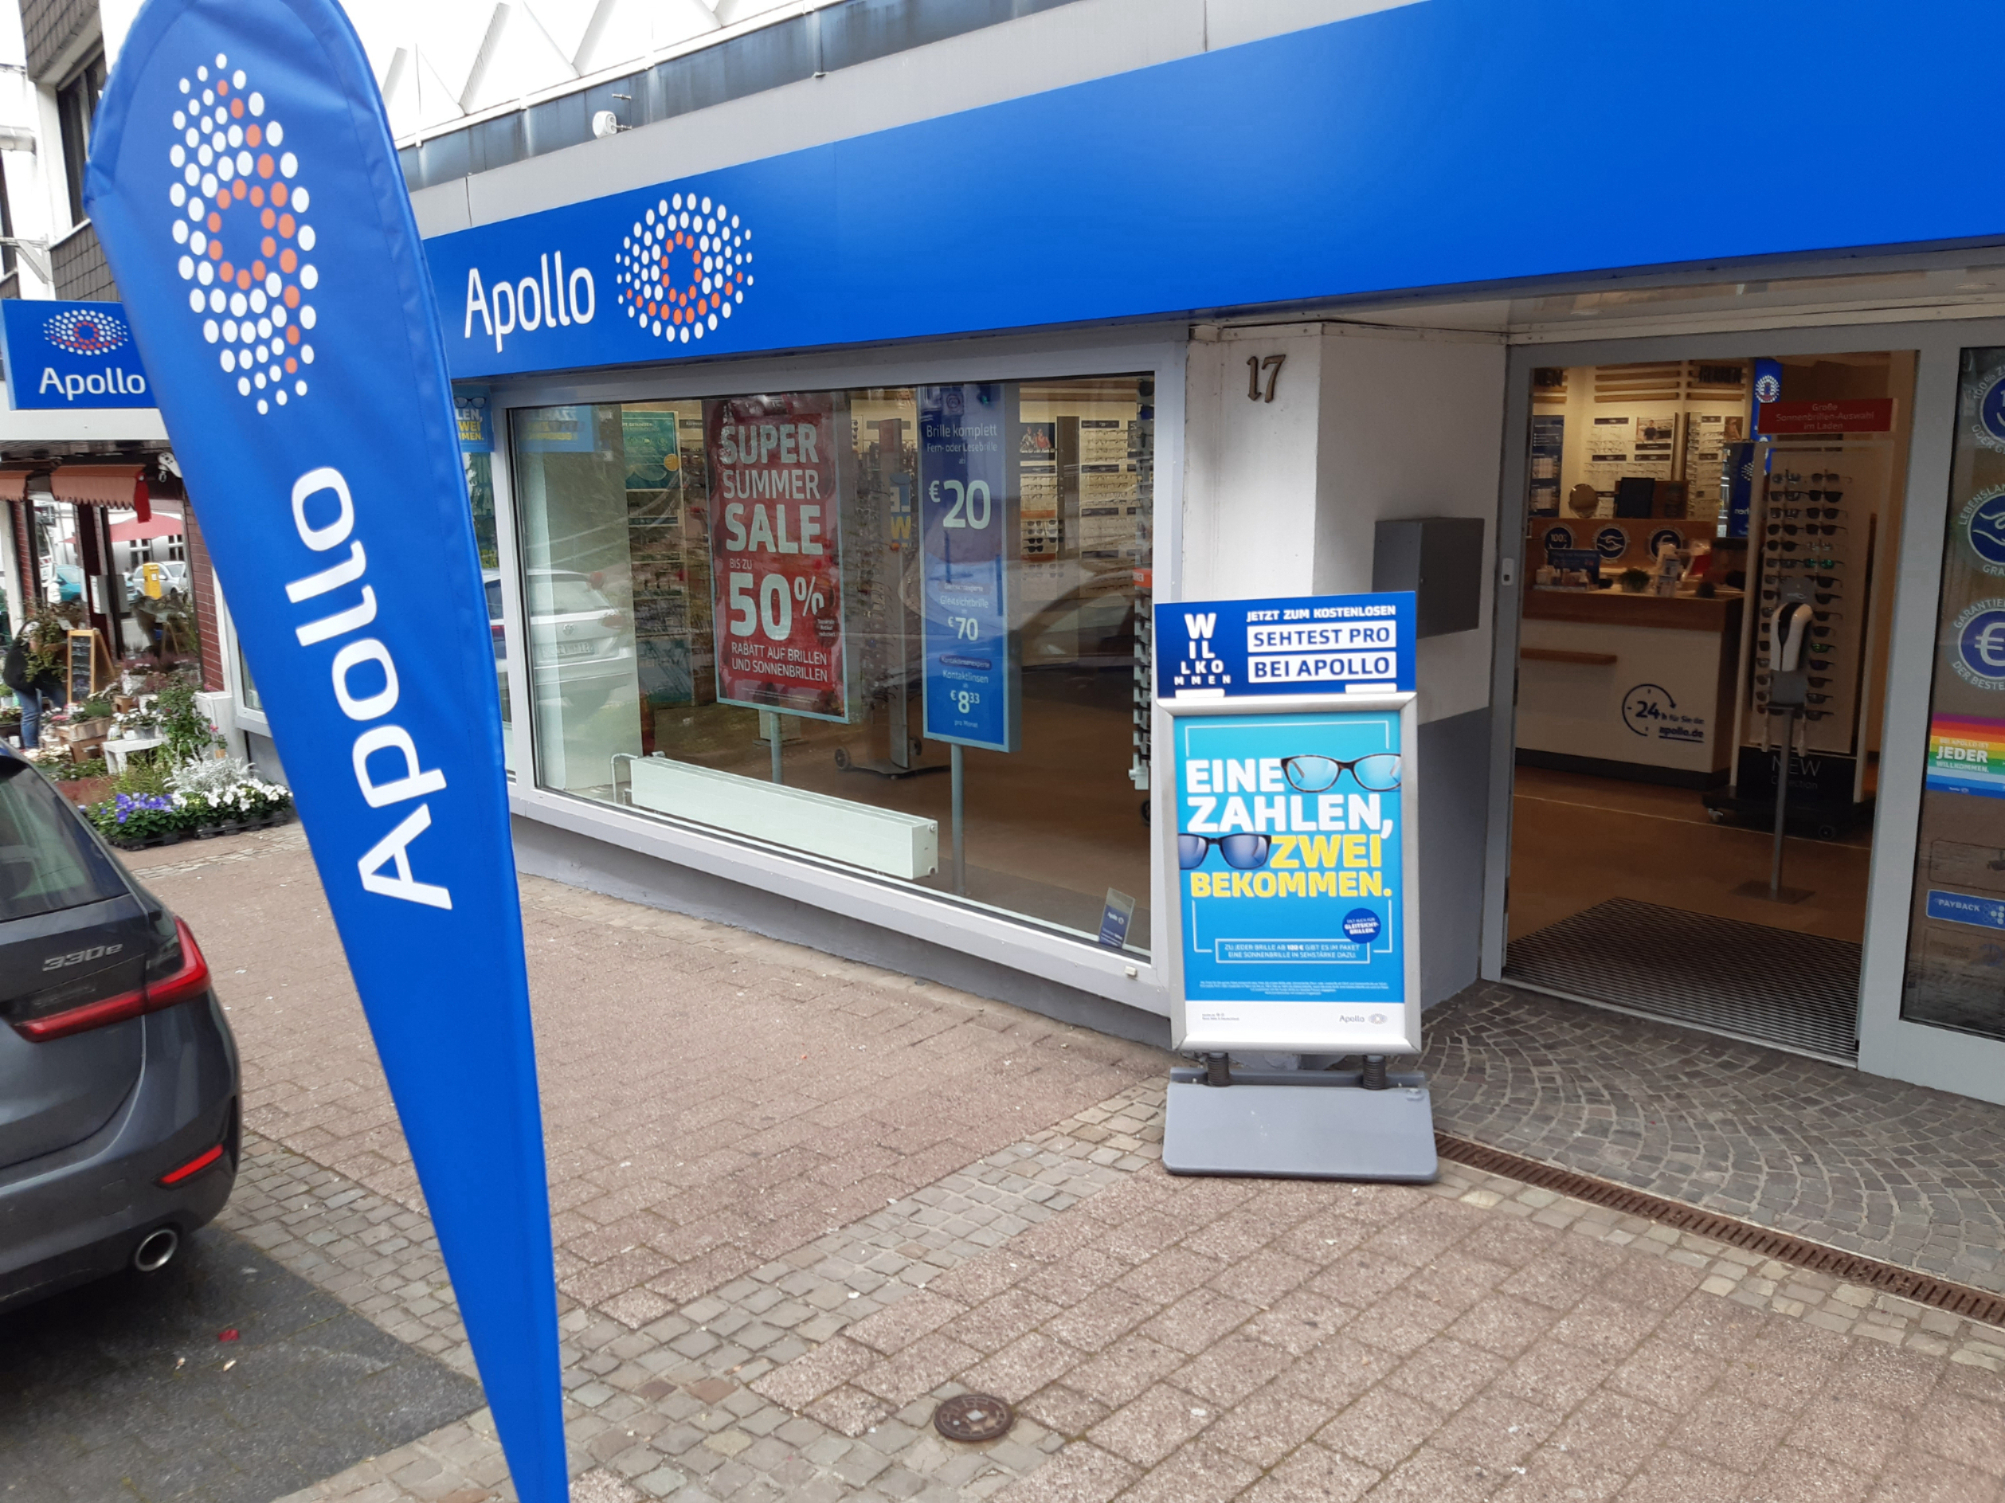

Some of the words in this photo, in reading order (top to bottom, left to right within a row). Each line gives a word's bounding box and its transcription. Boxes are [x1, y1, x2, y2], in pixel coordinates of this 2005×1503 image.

[464, 250, 596, 354] Apollo
[38, 367, 147, 401] Apollo
[1246, 354, 1286, 403] 17
[1812, 403, 1838, 411] Große
[457, 421, 481, 432] WEI
[459, 432, 484, 441] MEN.
[926, 424, 951, 438] Brille
[952, 422, 998, 440] komplett
[1816, 422, 1844, 430] Laden
[719, 423, 820, 464] SUPER
[926, 443, 944, 452] Fern-
[945, 443, 961, 452] oder
[962, 441, 998, 452] Lesebrille
[722, 469, 821, 499] SUMMER
[724, 502, 824, 555] SALE
[729, 558, 741, 569] BIS
[741, 558, 753, 570] ZU
[729, 571, 825, 641] 50%
[1246, 610, 1280, 622] JETZT
[1283, 608, 1310, 620] ZUM
[1313, 605, 1397, 619] KOSTENLOSEN
[1953, 598, 2005, 628] GARANTIE
[1253, 628, 1343, 647] SEHTEST
[1349, 627, 1391, 644] PRO
[731, 641, 765, 658] RABATT
[767, 647, 786, 660] AUF
[787, 648, 827, 665] BRILLEN
[731, 658, 750, 672] UND
[752, 660, 828, 682] SONNENBRILLEN
[942, 669, 989, 684] Kontaktlinsen
[1254, 660, 1290, 678] BEI
[1296, 656, 1391, 677] APOLLO
[1952, 660, 1971, 680] DER
[284, 466, 453, 910] Apollo
[1659, 726, 1704, 738] apollo.de
[1951, 739, 1978, 747] APOLLO
[1935, 745, 1988, 763] JEDER
[1185, 758, 1285, 794] EINE
[1772, 755, 1821, 777] NEW
[1186, 793, 1394, 840] ZAHLEN,
[1269, 834, 1382, 869] ZWEI
[1190, 871, 1393, 898] BEKOMMEN.
[1937, 898, 1981, 913] PAYBACK
[42, 943, 123, 972] 330e
[1224, 943, 1234, 951] ZU
[1234, 943, 1253, 951] JEDER
[1254, 943, 1276, 951] BRILLE
[1276, 943, 1286, 951] AB
[1304, 943, 1320, 951] GIBT
[1320, 943, 1329, 951] ES
[1330, 943, 1338, 951] IM
[1340, 943, 1360, 951] PAKET
[1228, 951, 1242, 959] EINE
[1243, 951, 1290, 959] SONNENBRILLE
[1291, 951, 1299, 959] IN
[1299, 950, 1336, 959] SEHSTÄRKE
[1339, 1014, 1365, 1023] Apollo
